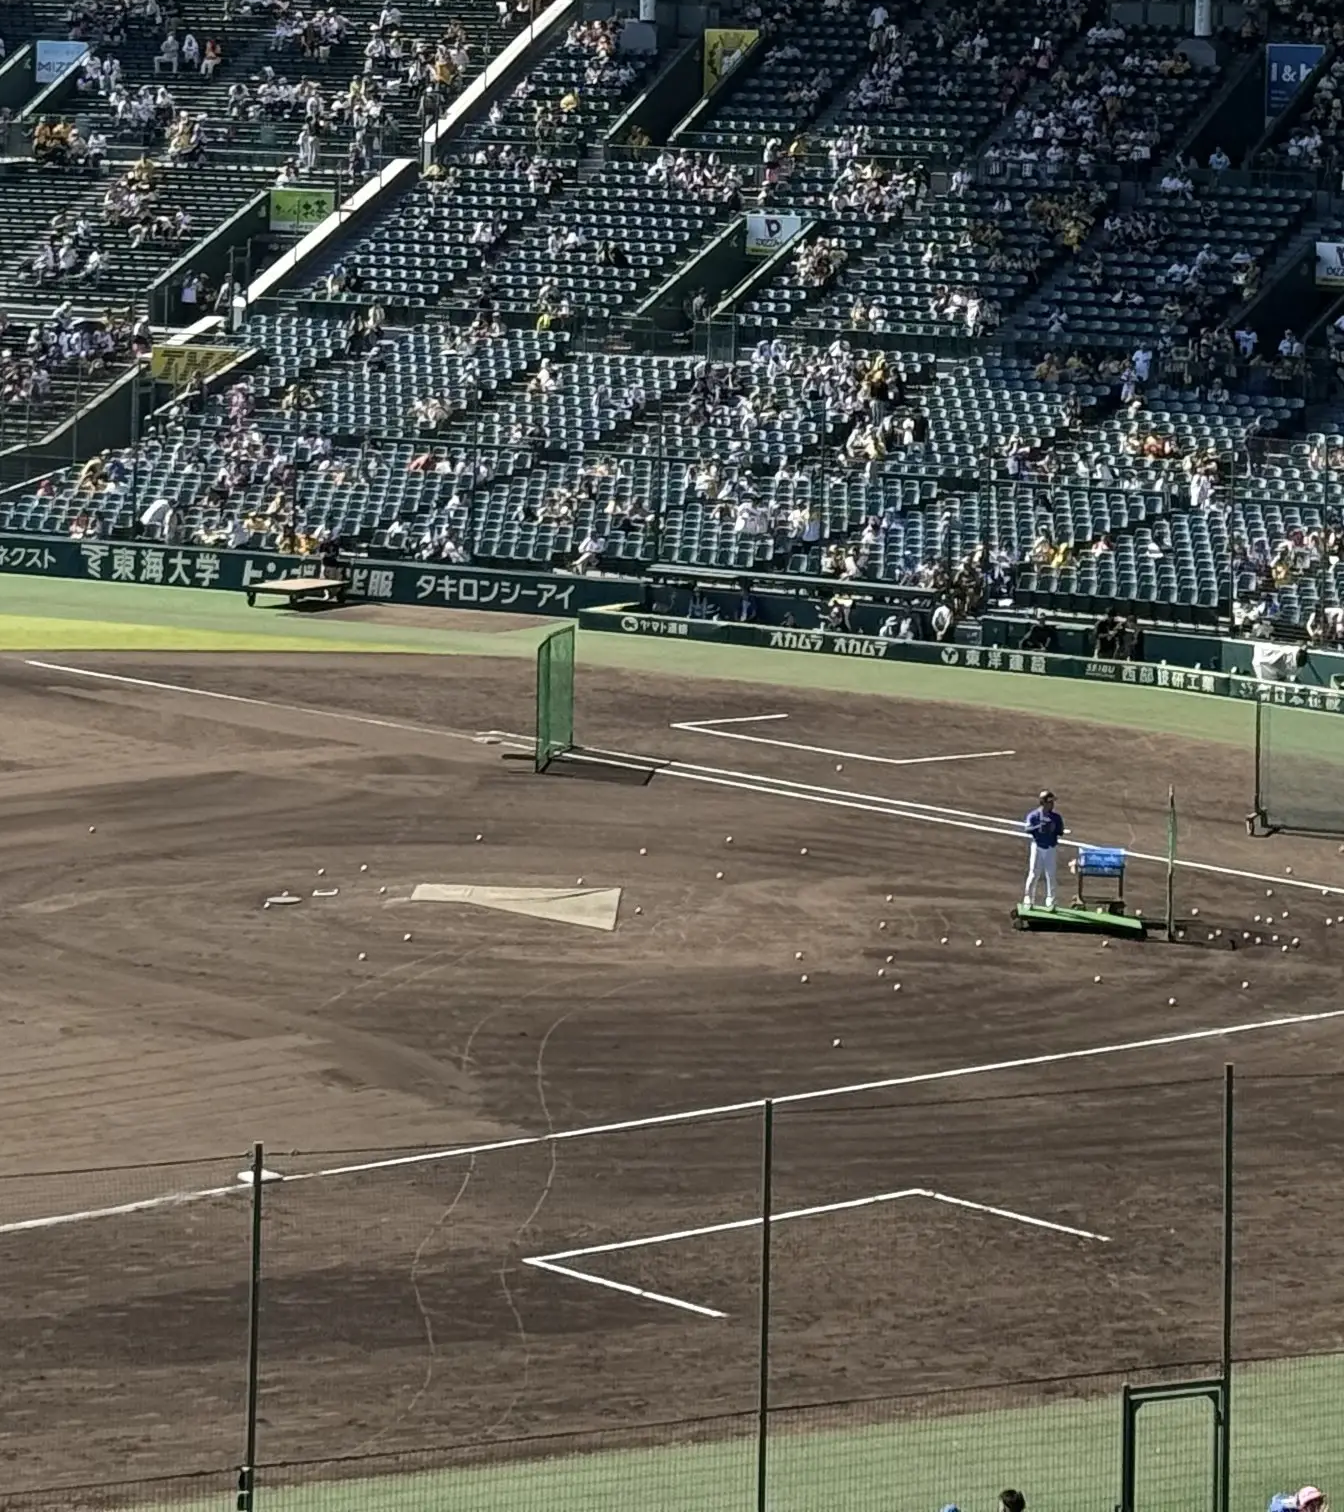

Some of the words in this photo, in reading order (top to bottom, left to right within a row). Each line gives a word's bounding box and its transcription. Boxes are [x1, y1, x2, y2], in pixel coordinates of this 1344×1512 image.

[112, 548, 222, 587] 東海大学
[416, 577, 575, 612] タキロンシーアイ
[769, 630, 824, 652] オカムラ
[833, 638, 889, 658] オカムラ
